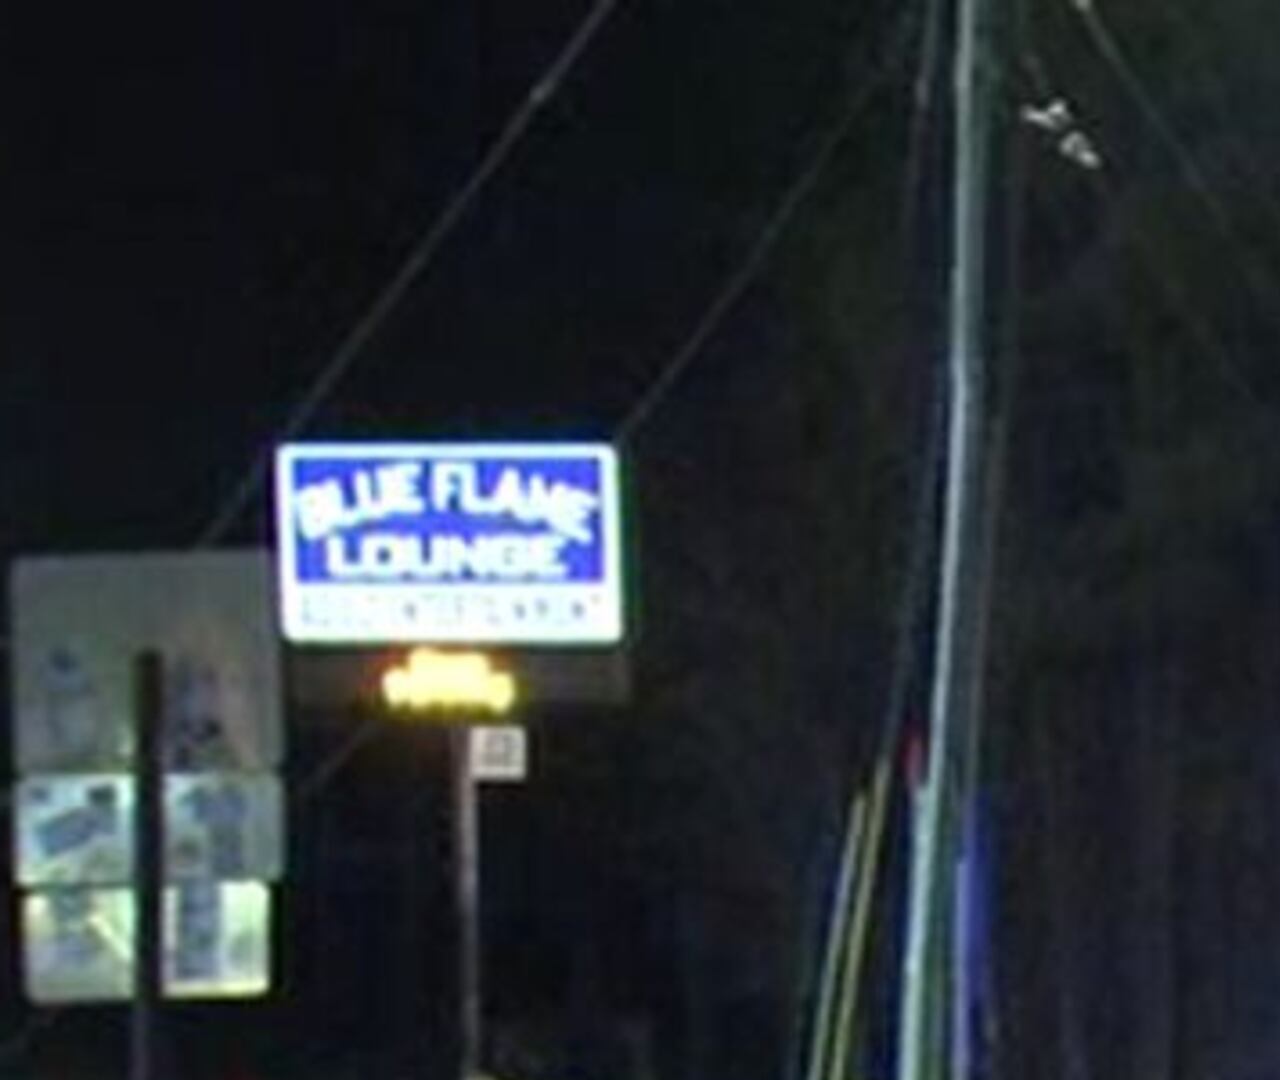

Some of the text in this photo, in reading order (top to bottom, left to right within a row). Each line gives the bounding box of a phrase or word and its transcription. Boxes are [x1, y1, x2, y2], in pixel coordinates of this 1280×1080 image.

[297, 462, 598, 543] BLUE FLAME
[327, 534, 570, 577] LOUNGE
